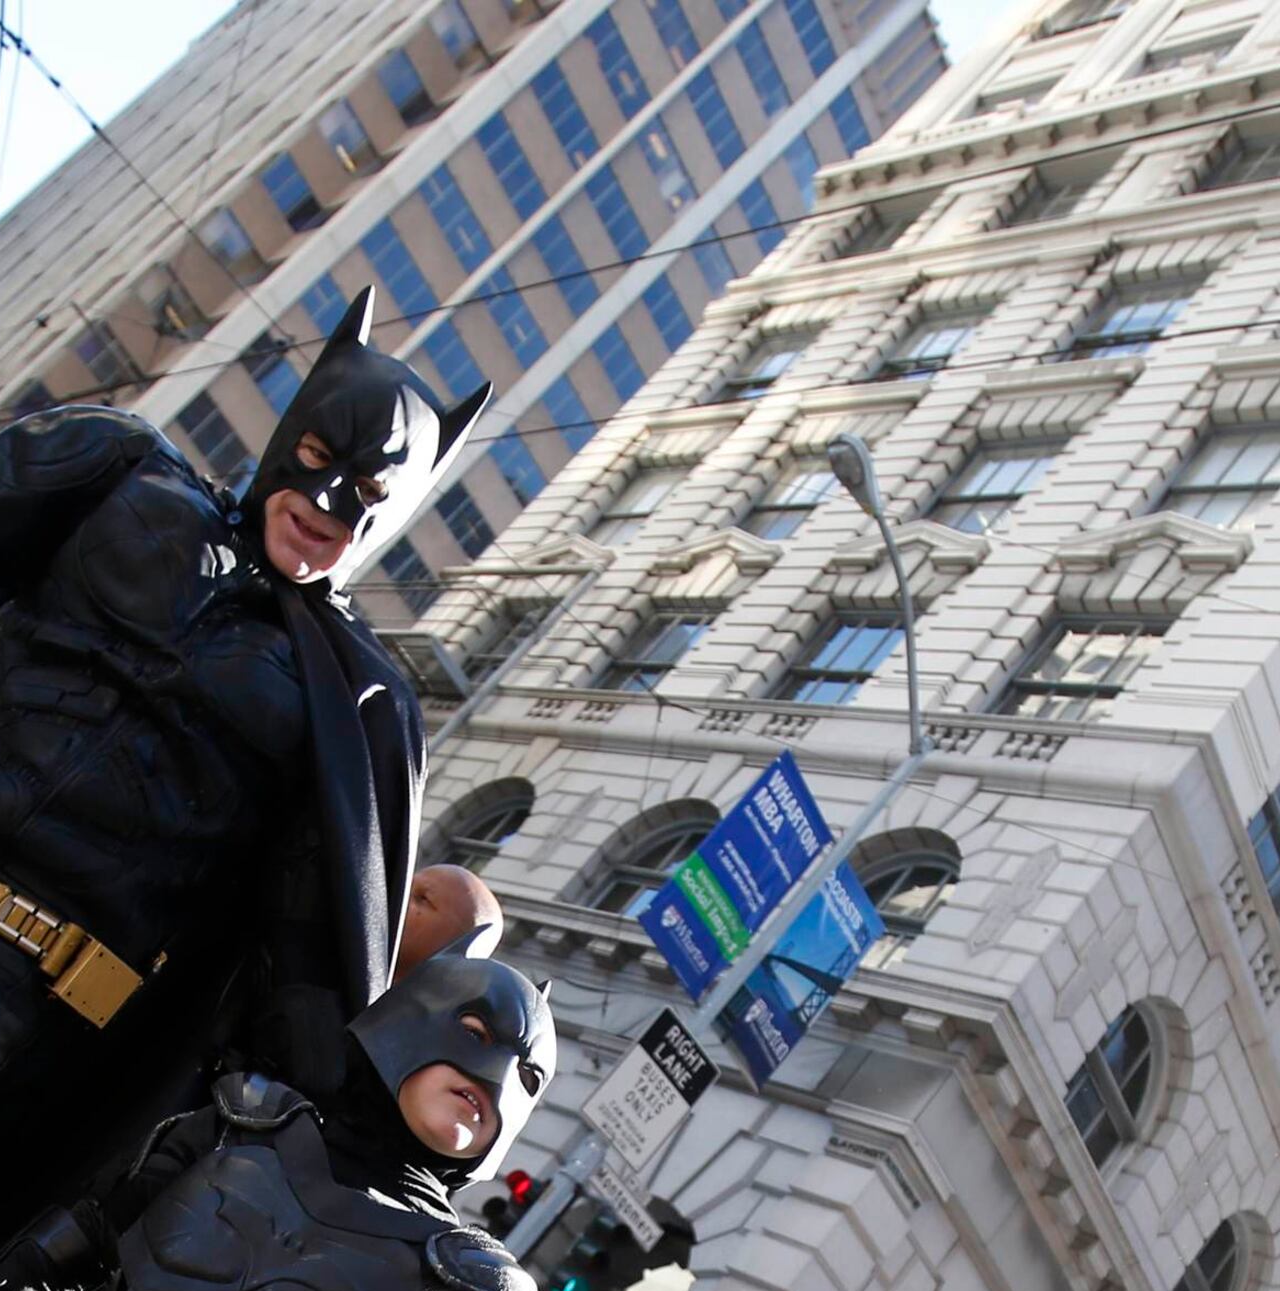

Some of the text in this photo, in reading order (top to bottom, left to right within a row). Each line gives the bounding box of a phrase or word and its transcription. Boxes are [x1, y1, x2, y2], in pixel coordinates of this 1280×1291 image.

[753, 786, 784, 834] MBA
[768, 769, 820, 857] WHARTON
[680, 867, 713, 911] Social
[707, 906, 738, 953] Impact
[674, 918, 710, 972] Wharton
[652, 1042, 692, 1090] LANE
[664, 1024, 706, 1073] RIGHT
[624, 1090, 654, 1123] ONLY
[634, 1077, 665, 1115] TAXIS
[641, 1061, 677, 1105] BUSES
[595, 1167, 654, 1242] Montgomery
